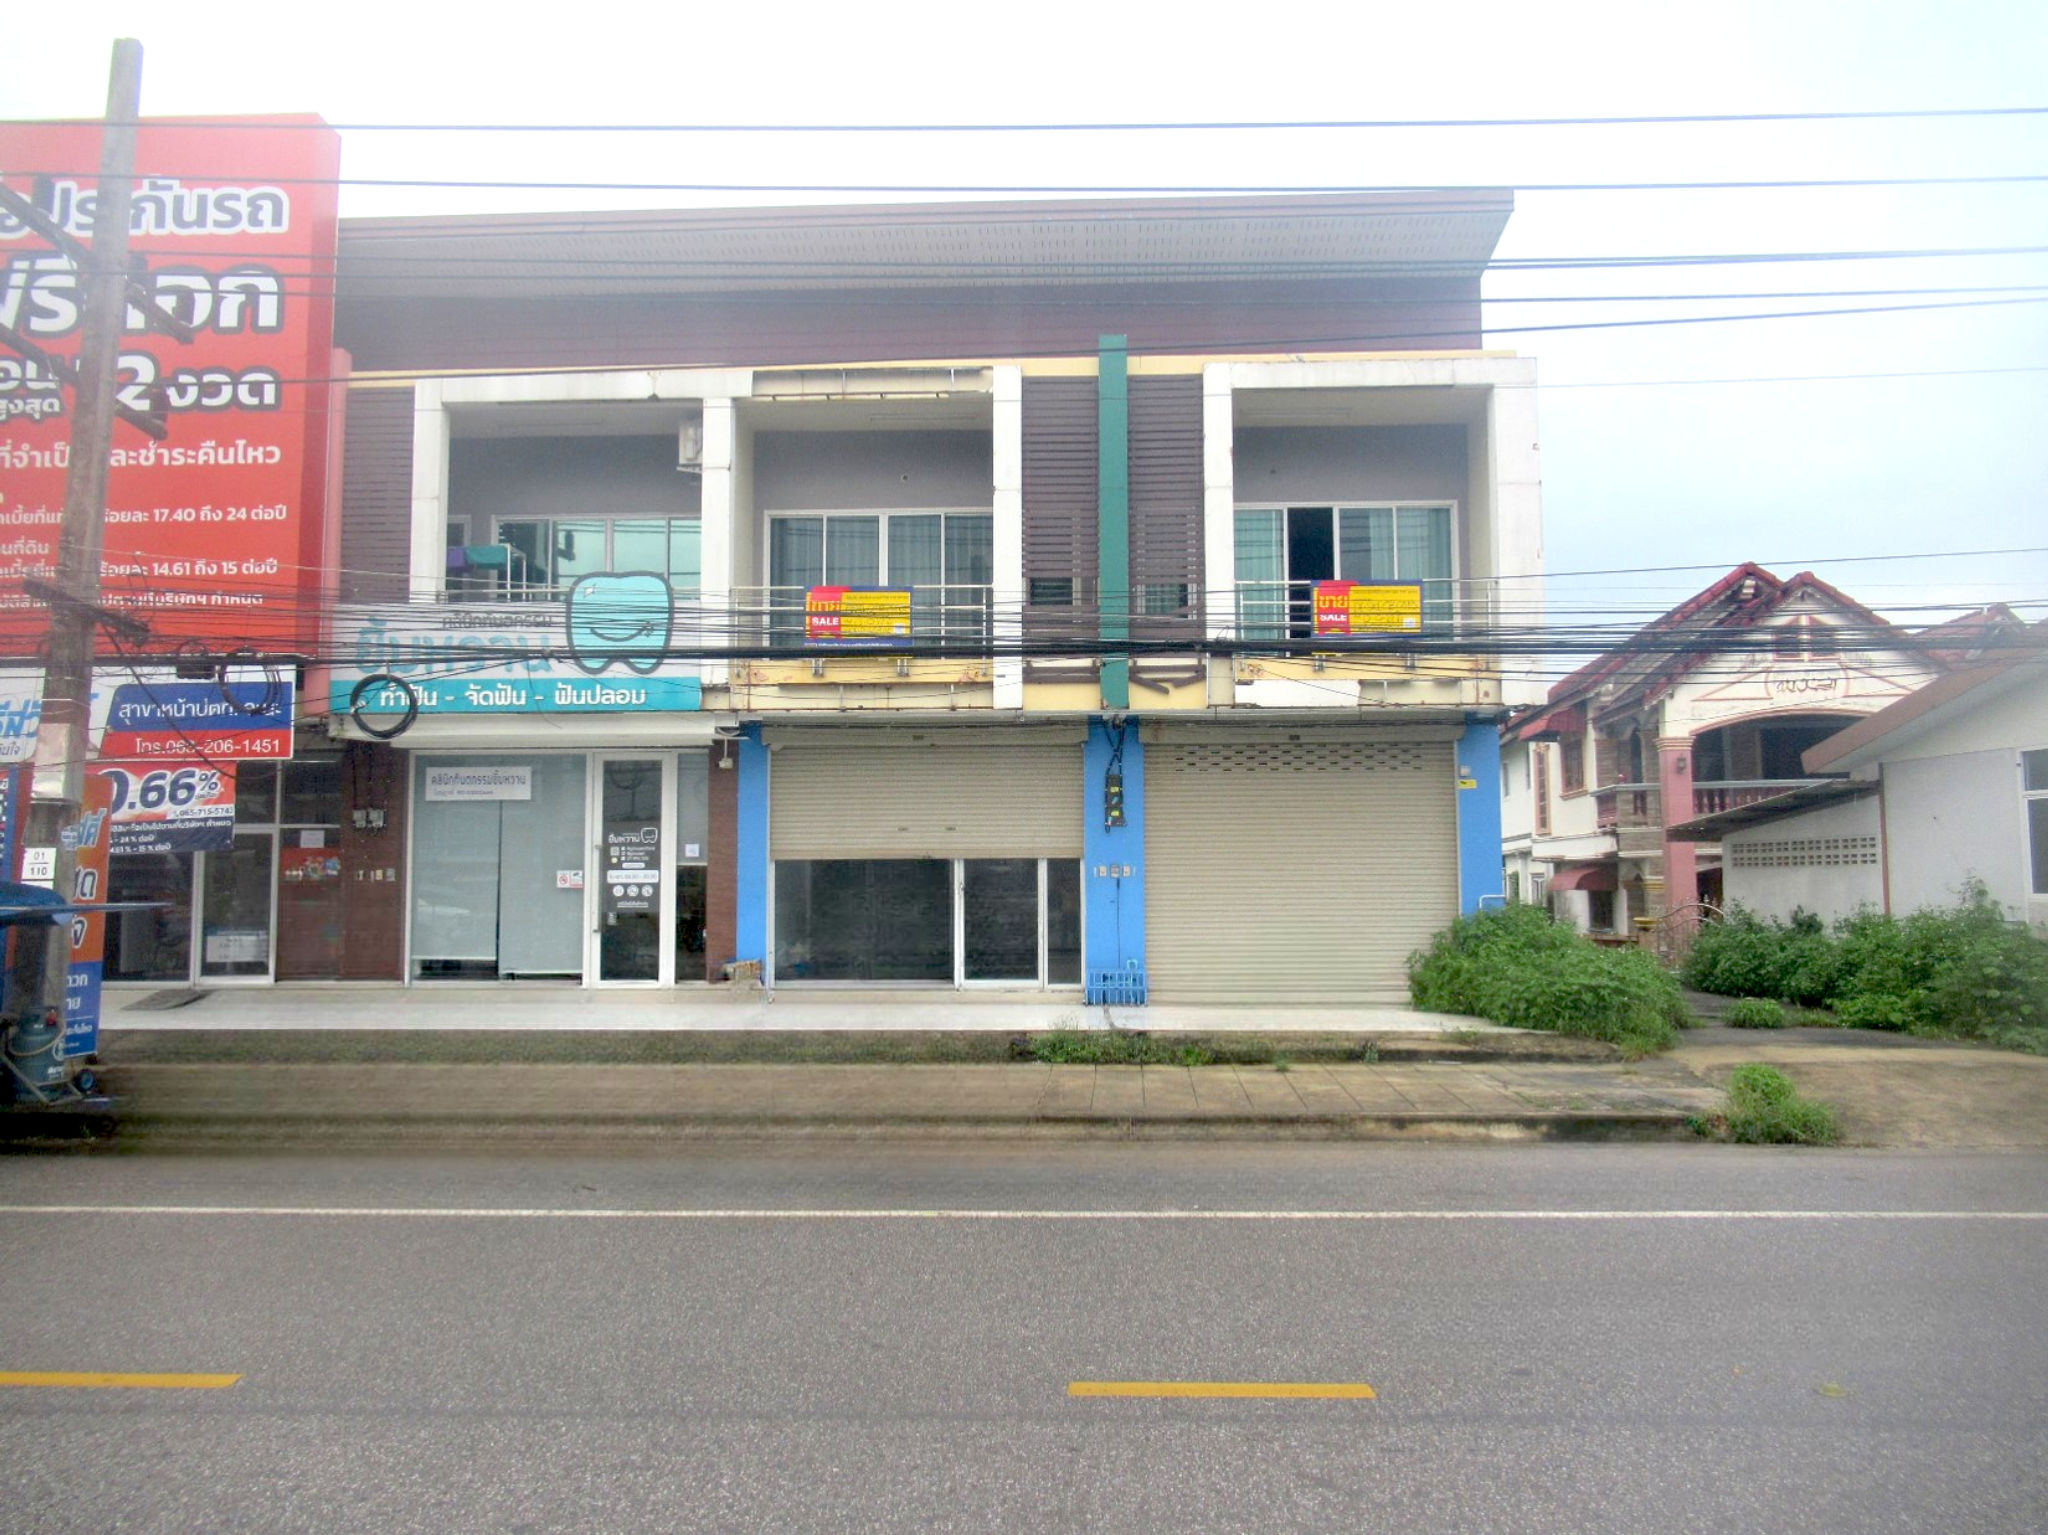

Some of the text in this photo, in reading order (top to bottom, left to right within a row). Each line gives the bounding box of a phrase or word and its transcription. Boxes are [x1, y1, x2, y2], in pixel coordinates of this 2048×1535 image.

[153, 508, 196, 522] 17.40
[200, 505, 223, 522] ถึง
[226, 507, 248, 521] 24
[251, 504, 287, 522] ต่อปี
[152, 562, 191, 576] 14.61
[195, 559, 217, 576] ถึง
[221, 561, 238, 575] 15
[241, 557, 278, 575] ต่อปี
[811, 617, 840, 626] SALE
[1320, 614, 1348, 622] SALE
[465, 684, 526, 706] จัดฟัน
[554, 683, 646, 706] ฟันปลอม
